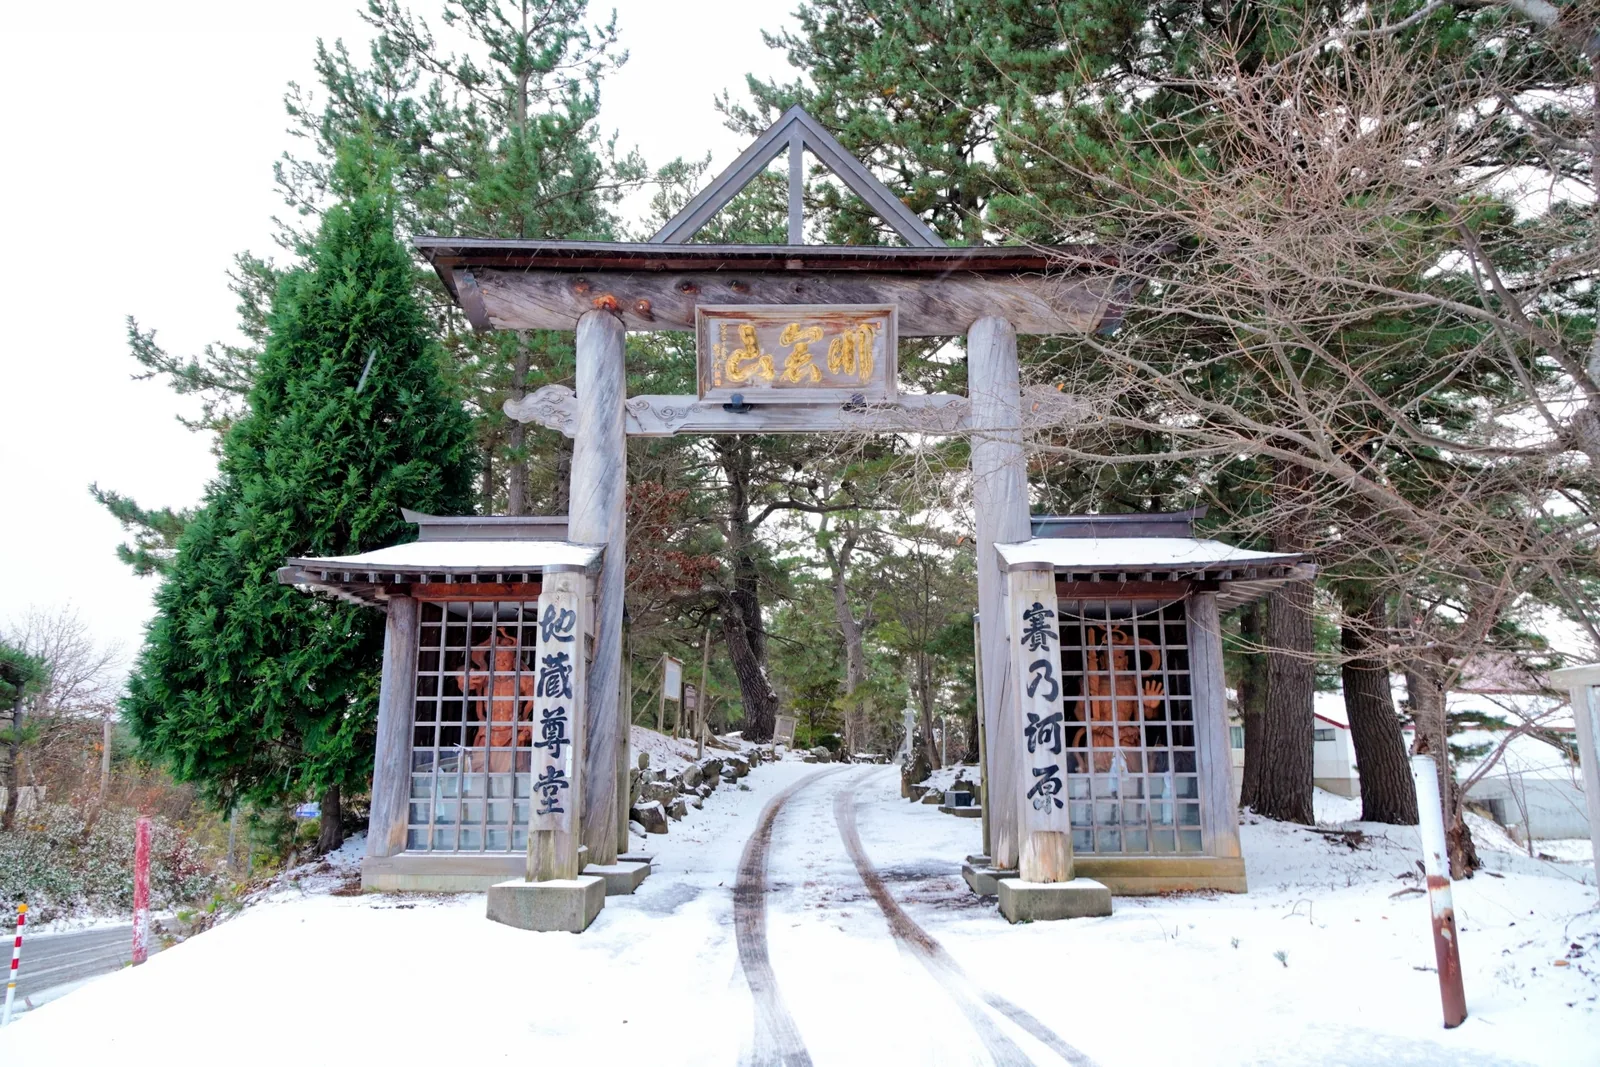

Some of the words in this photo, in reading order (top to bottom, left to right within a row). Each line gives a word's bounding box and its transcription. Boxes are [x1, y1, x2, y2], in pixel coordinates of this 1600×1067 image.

[533, 604, 577, 815] 地蔵尊堂
[1020, 602, 1064, 815] 賽乃河原
